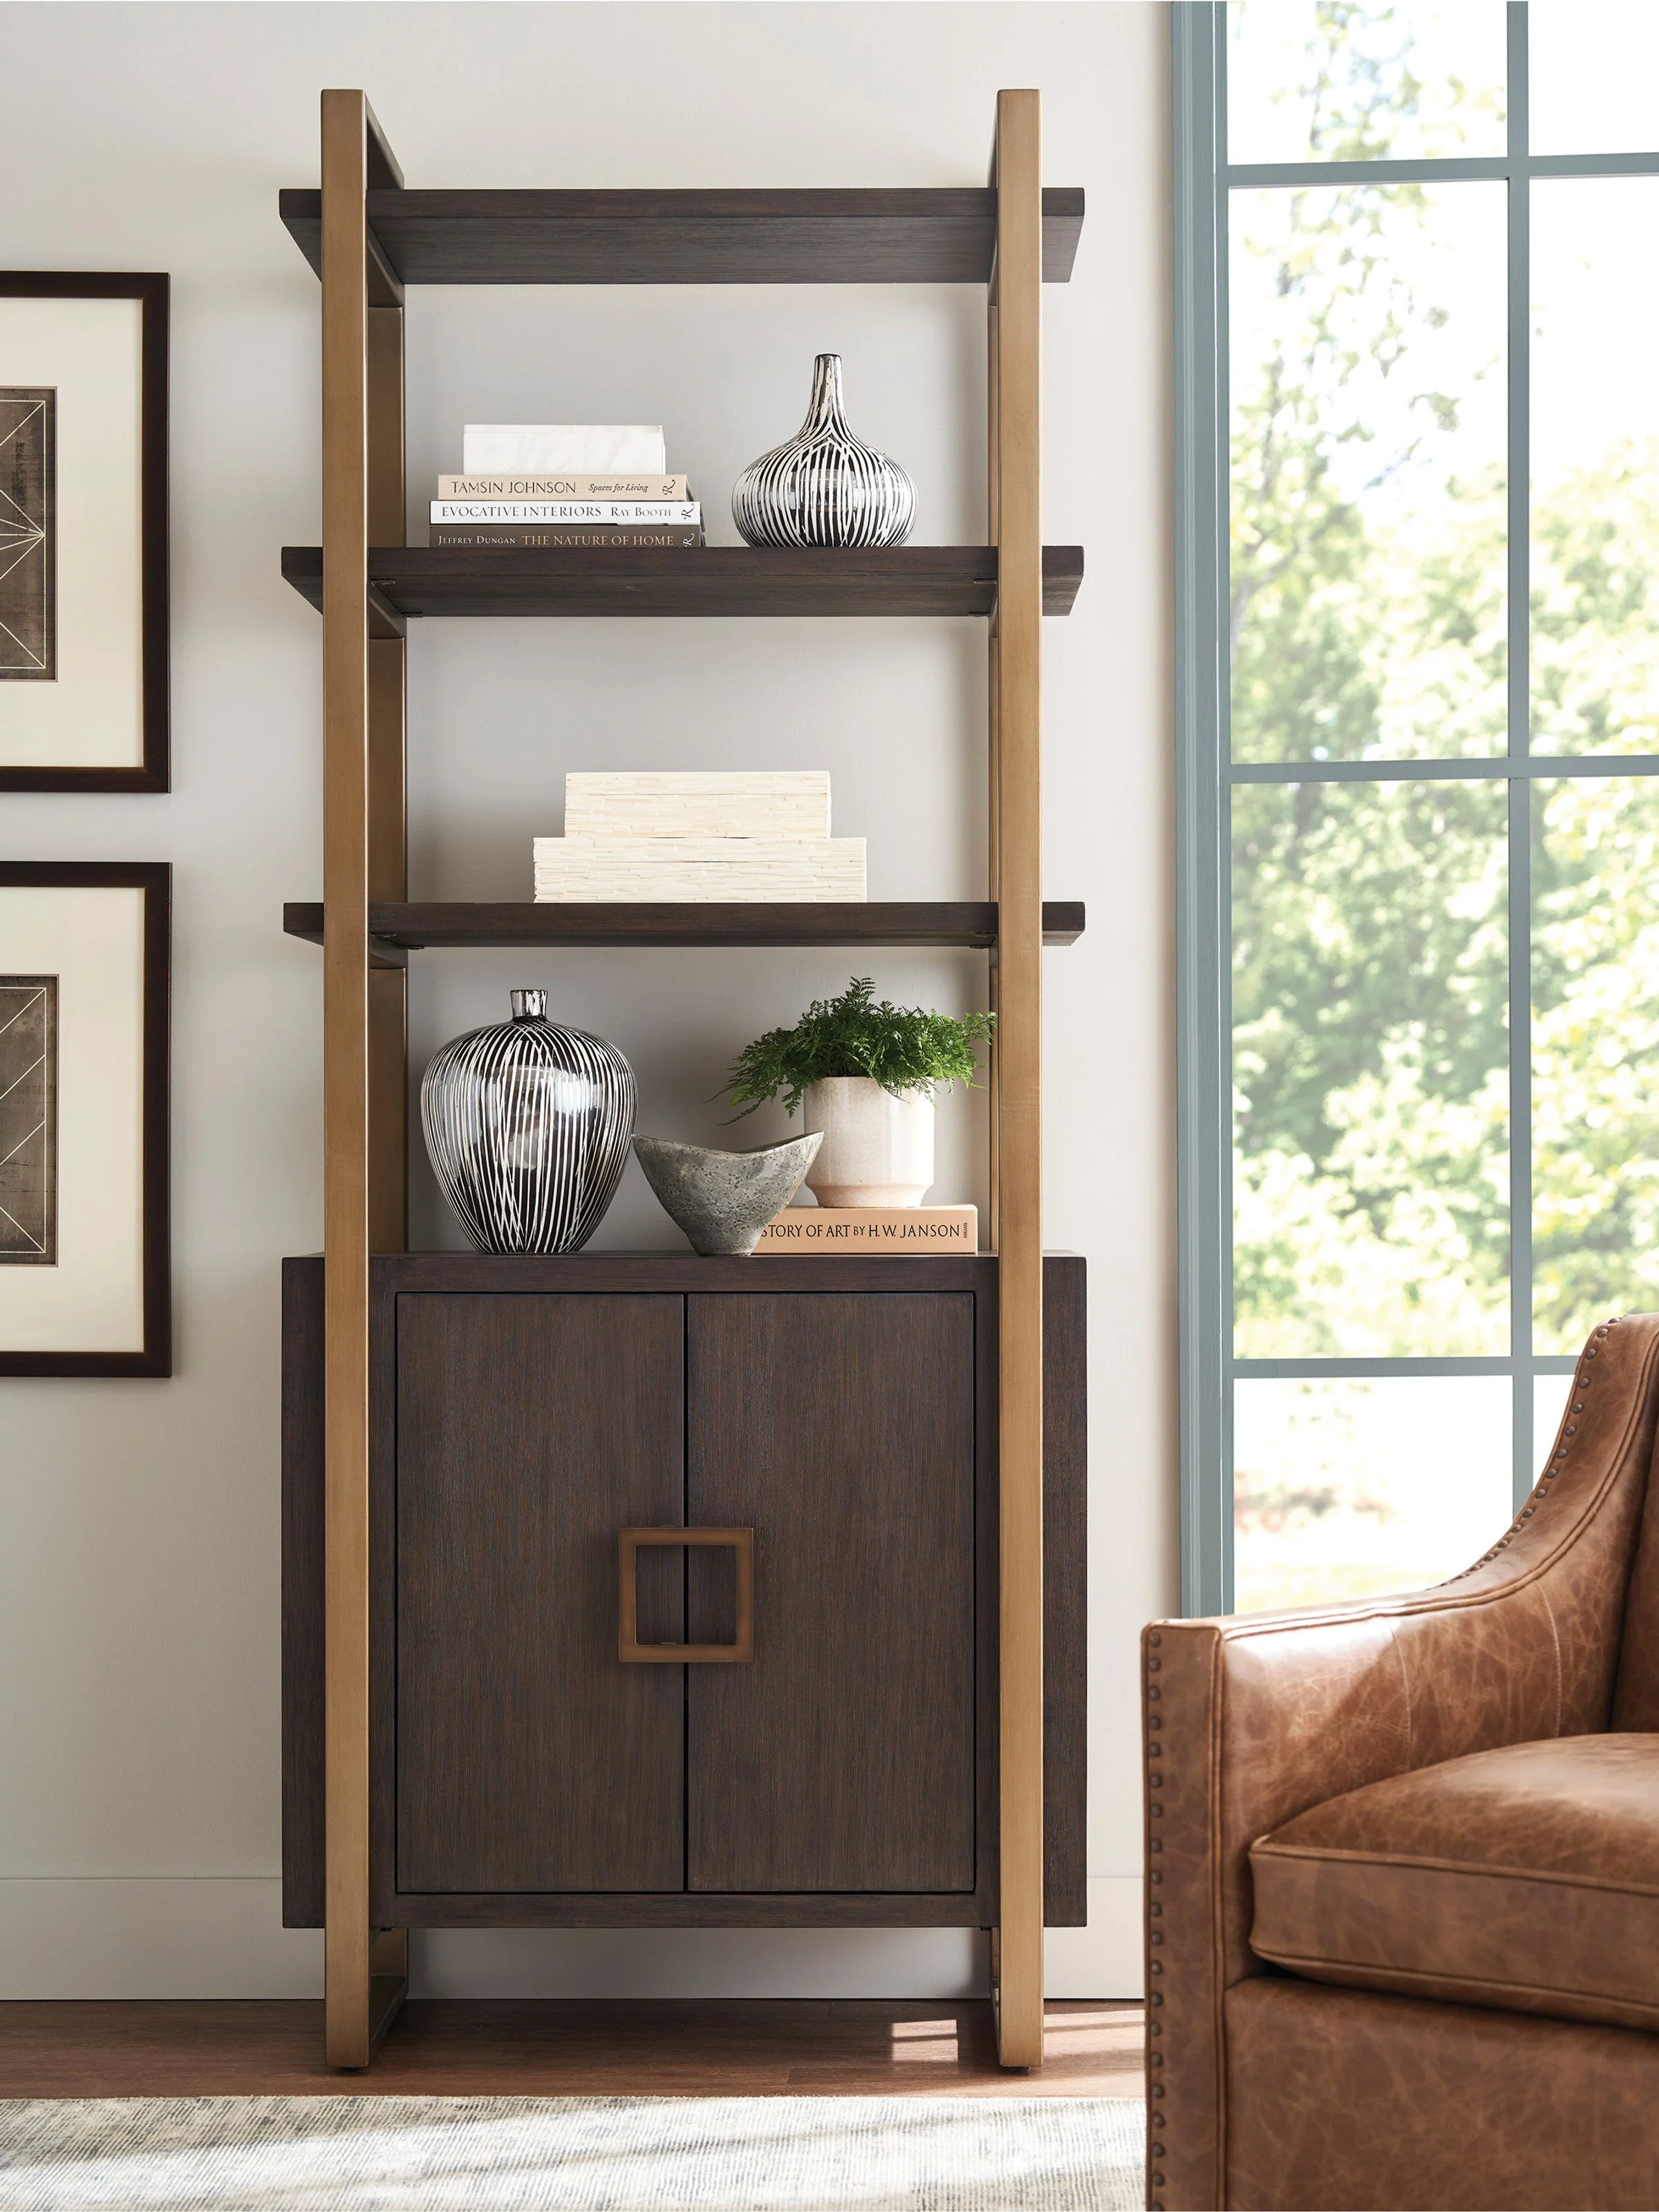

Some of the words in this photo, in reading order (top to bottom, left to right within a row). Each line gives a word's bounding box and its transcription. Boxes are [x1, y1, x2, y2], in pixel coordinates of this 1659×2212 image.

[451, 482, 503, 494] TAMSIN
[508, 482, 576, 494] JOHNSON
[588, 483, 612, 493] Spaces
[612, 483, 624, 493] for
[625, 483, 649, 493] Living
[442, 507, 519, 517] EVOCATIVE
[523, 507, 602, 517] INTERIORS
[438, 535, 473, 545] JEFFREY
[476, 535, 516, 545] DUNGAN
[521, 535, 550, 545] THE
[554, 535, 608, 545] NATURE
[611, 535, 630, 545] OF
[633, 535, 674, 545] HOME
[805, 1224, 823, 1237] OF
[826, 1224, 851, 1237] ART
[853, 1226, 865, 1236] BY
[899, 1224, 959, 1238] JANSON
